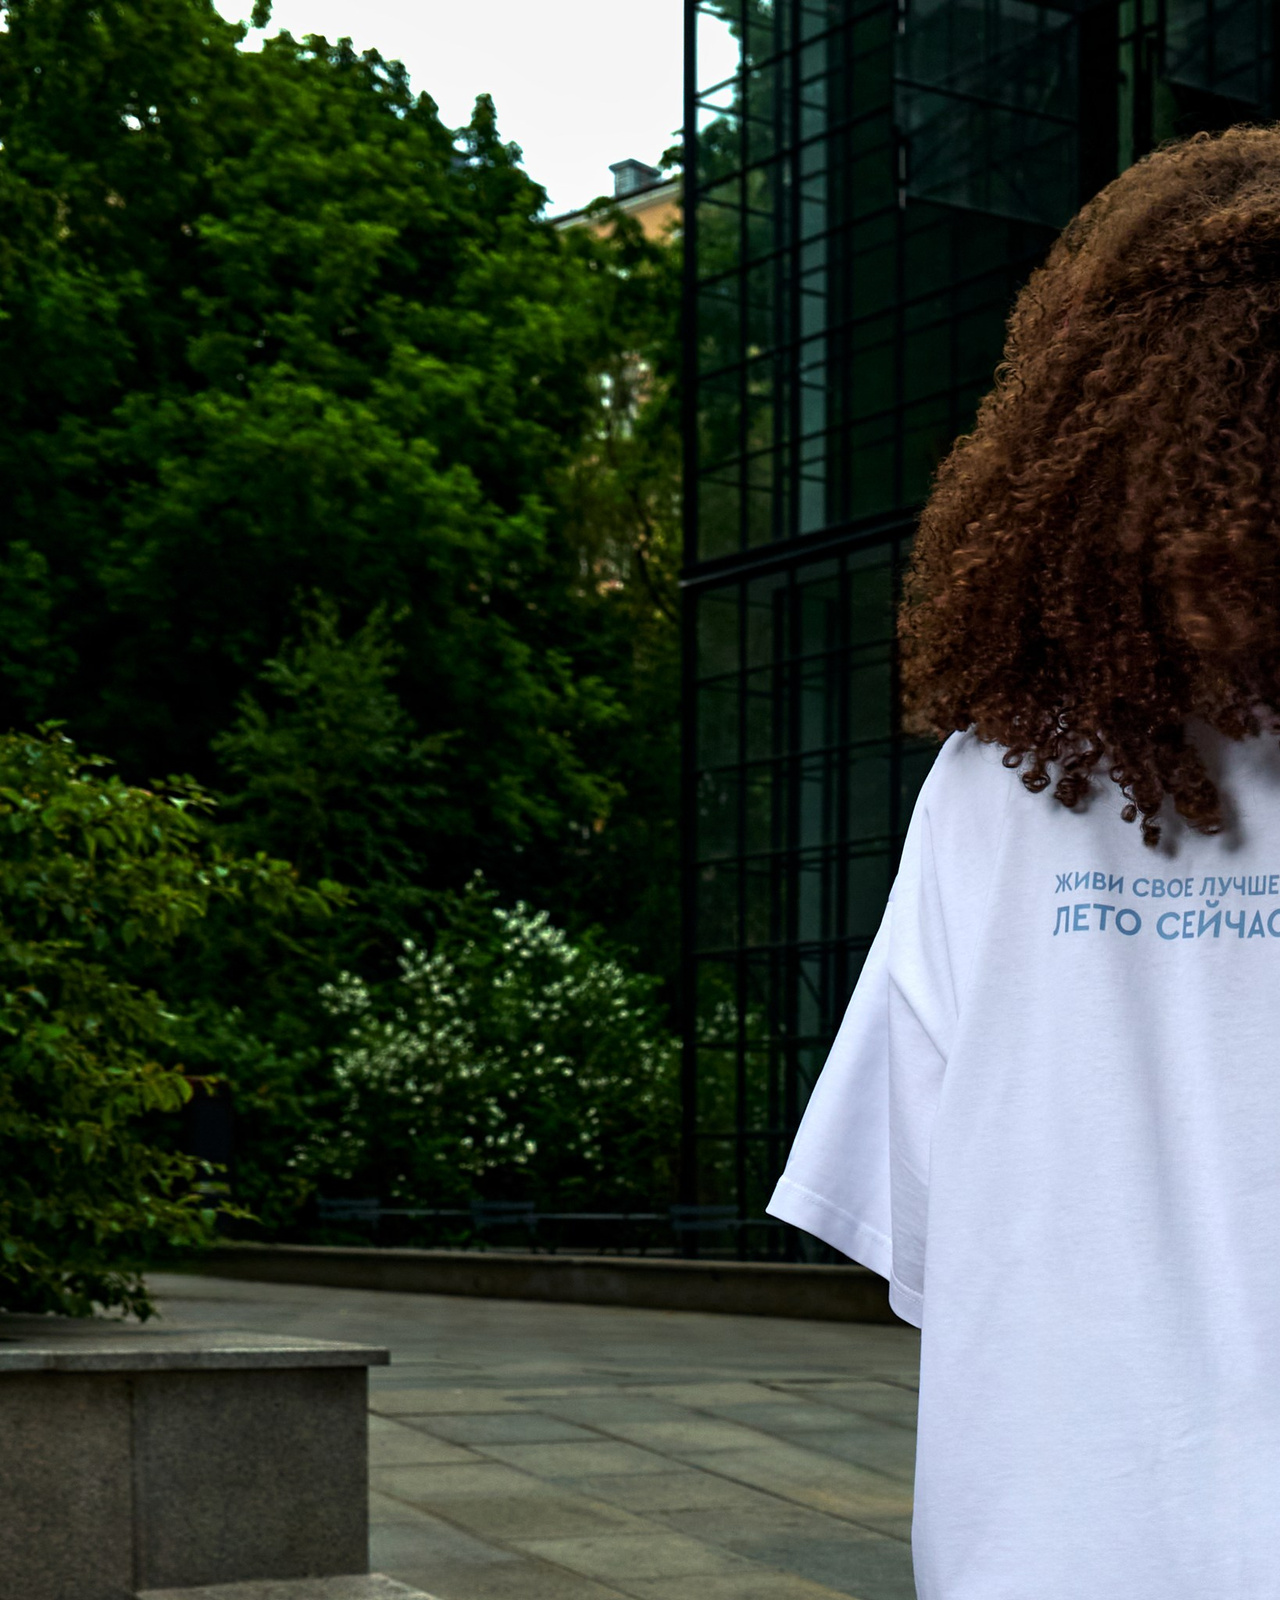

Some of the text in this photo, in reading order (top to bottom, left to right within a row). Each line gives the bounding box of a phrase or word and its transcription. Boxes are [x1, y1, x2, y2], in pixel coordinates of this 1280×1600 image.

[1055, 871, 1124, 894] ЖИВИ
[1132, 877, 1194, 898] СВОЕ
[1053, 903, 1142, 936] ЛЕТО
